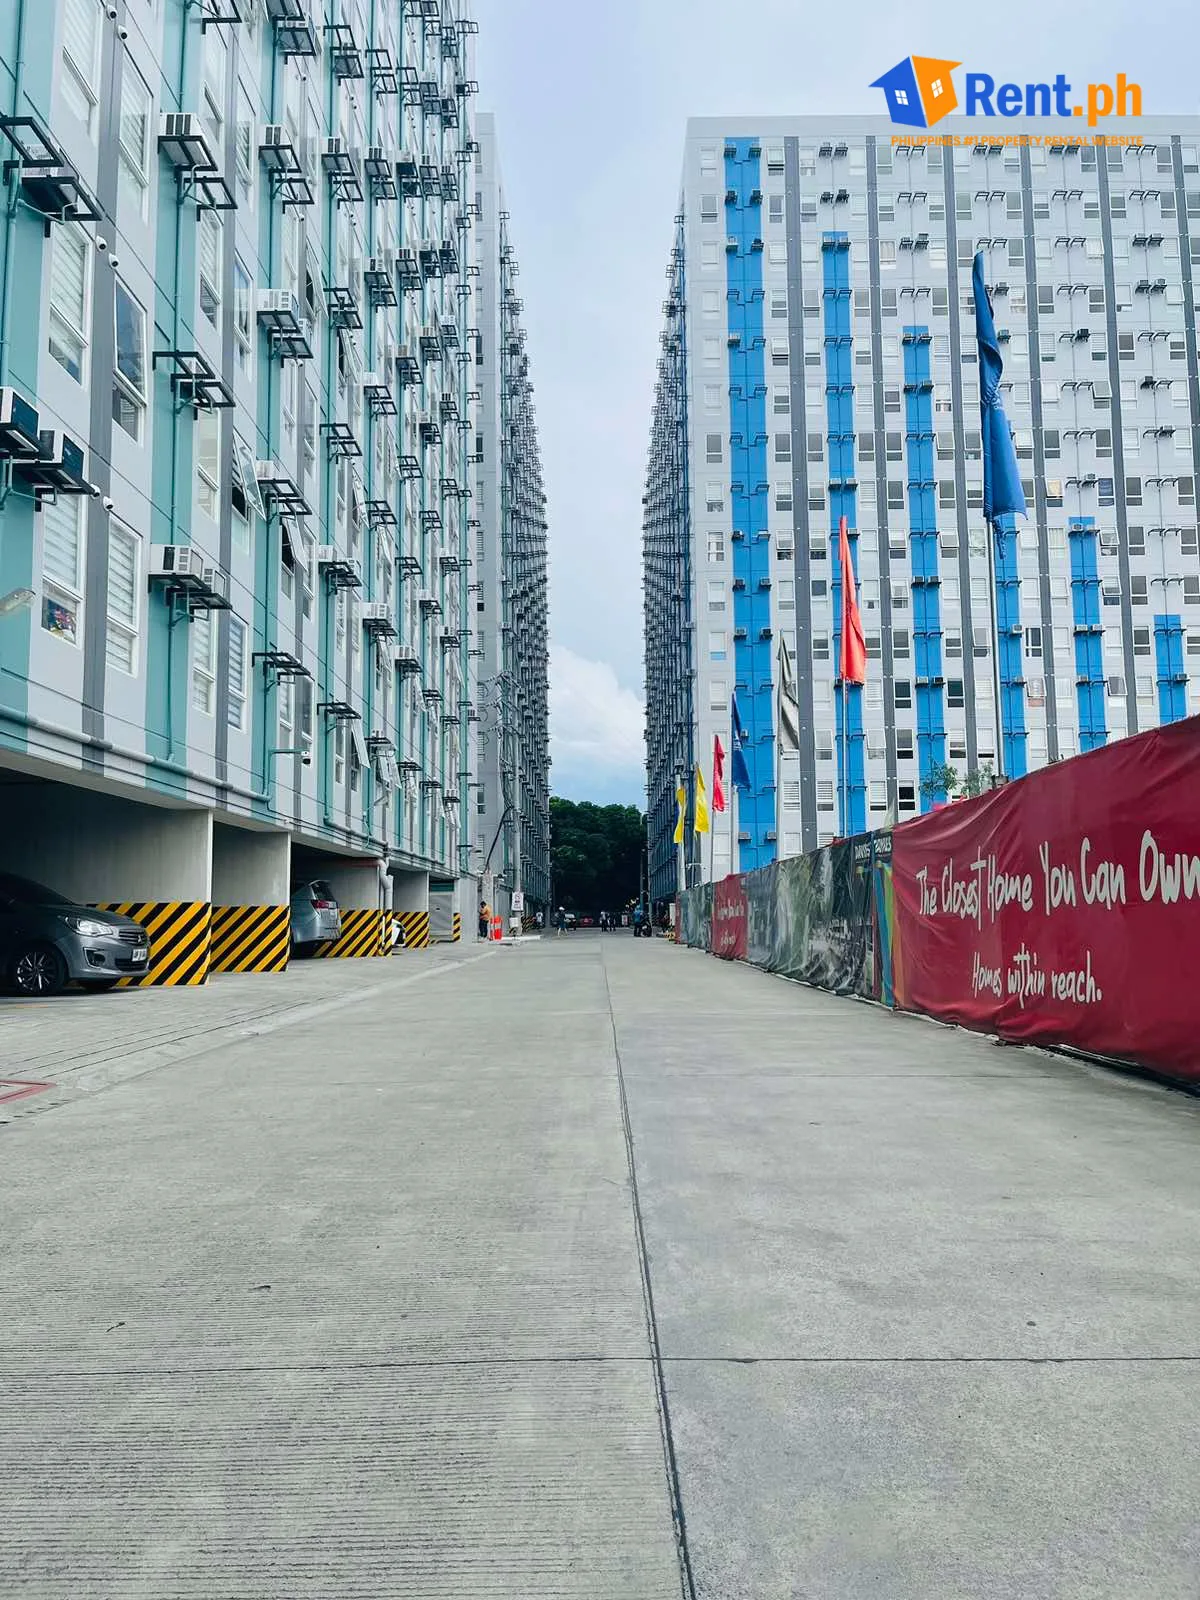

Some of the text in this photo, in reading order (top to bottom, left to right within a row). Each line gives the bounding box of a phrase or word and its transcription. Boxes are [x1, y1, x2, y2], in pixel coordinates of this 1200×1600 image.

[915, 828, 1200, 932] The Closest Home You Can Own
[971, 942, 1103, 1009] Homes within reach.
